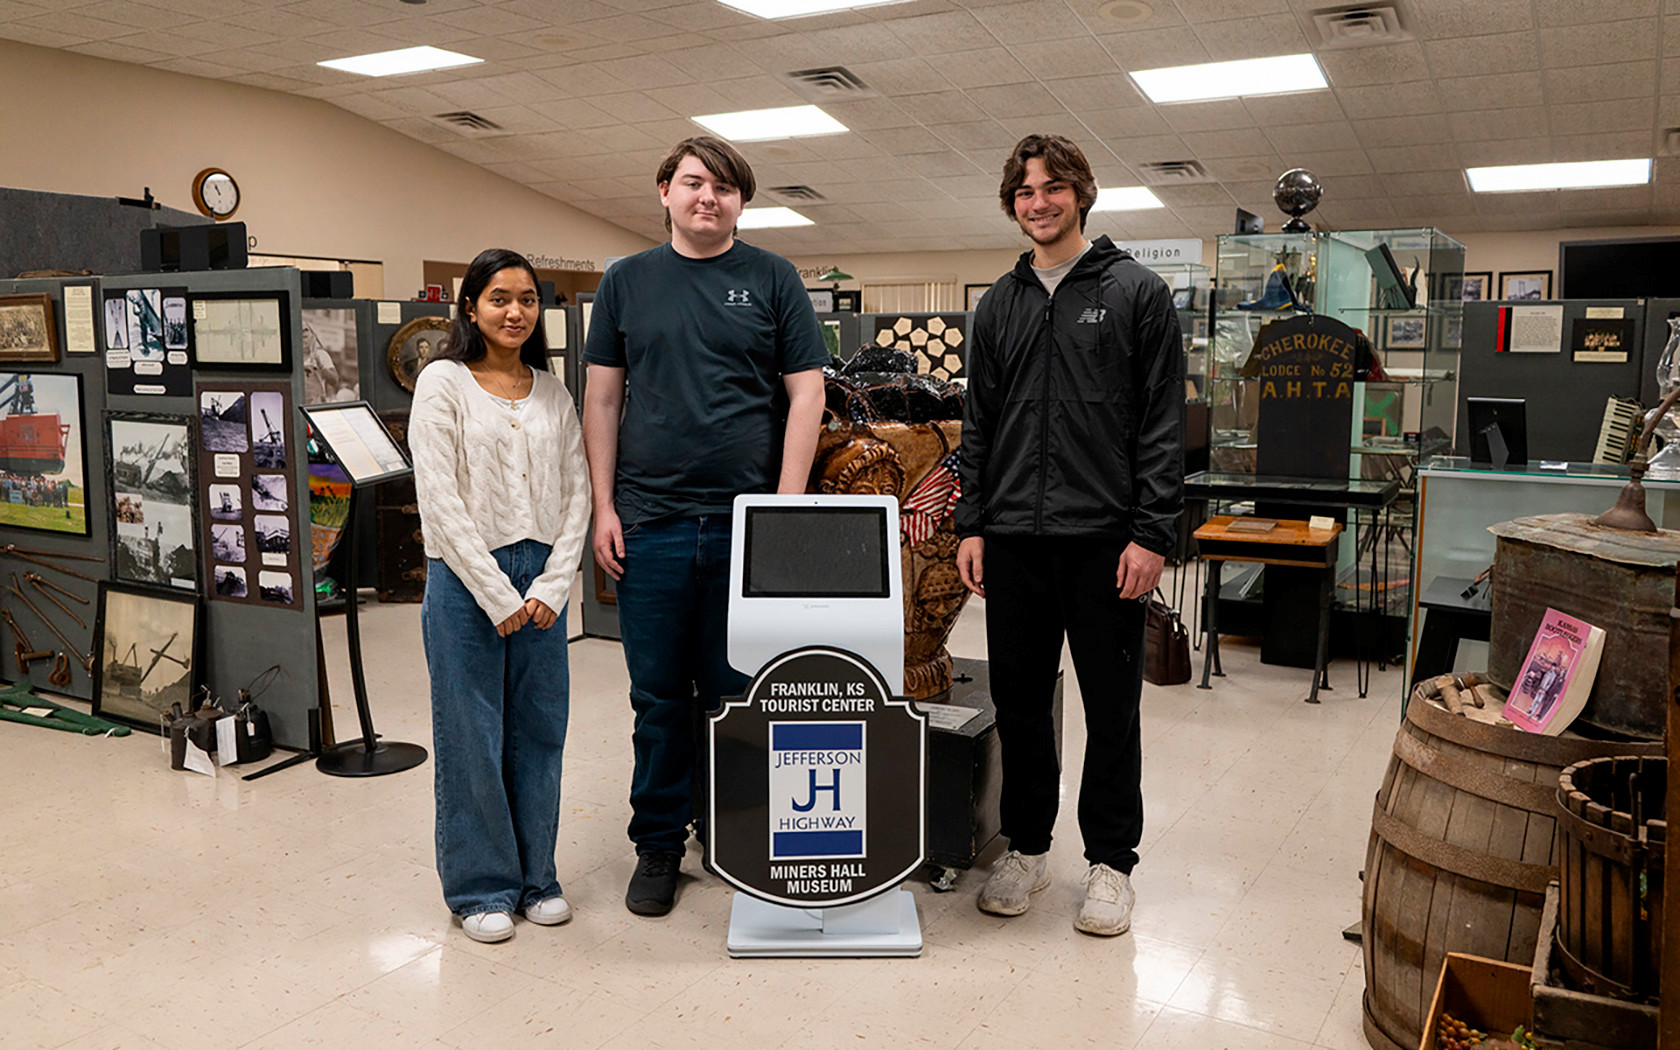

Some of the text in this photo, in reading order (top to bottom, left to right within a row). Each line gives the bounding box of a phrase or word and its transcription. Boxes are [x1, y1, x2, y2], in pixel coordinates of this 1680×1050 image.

[526, 254, 596, 271] Refreshments
[1125, 248, 1181, 260] Religion
[1261, 333, 1354, 360] CHEROKEE
[1262, 364, 1301, 377] LODGE
[1329, 362, 1353, 378] 52
[771, 682, 866, 699] FRANKLIN, KS
[760, 698, 875, 713] TOURIST CENTER
[774, 751, 862, 769] JEFFERSON
[791, 768, 841, 813] JH
[779, 816, 856, 831] HIGHWAY
[770, 863, 867, 880] MINERS HALL
[787, 879, 853, 894] MUSEUM
